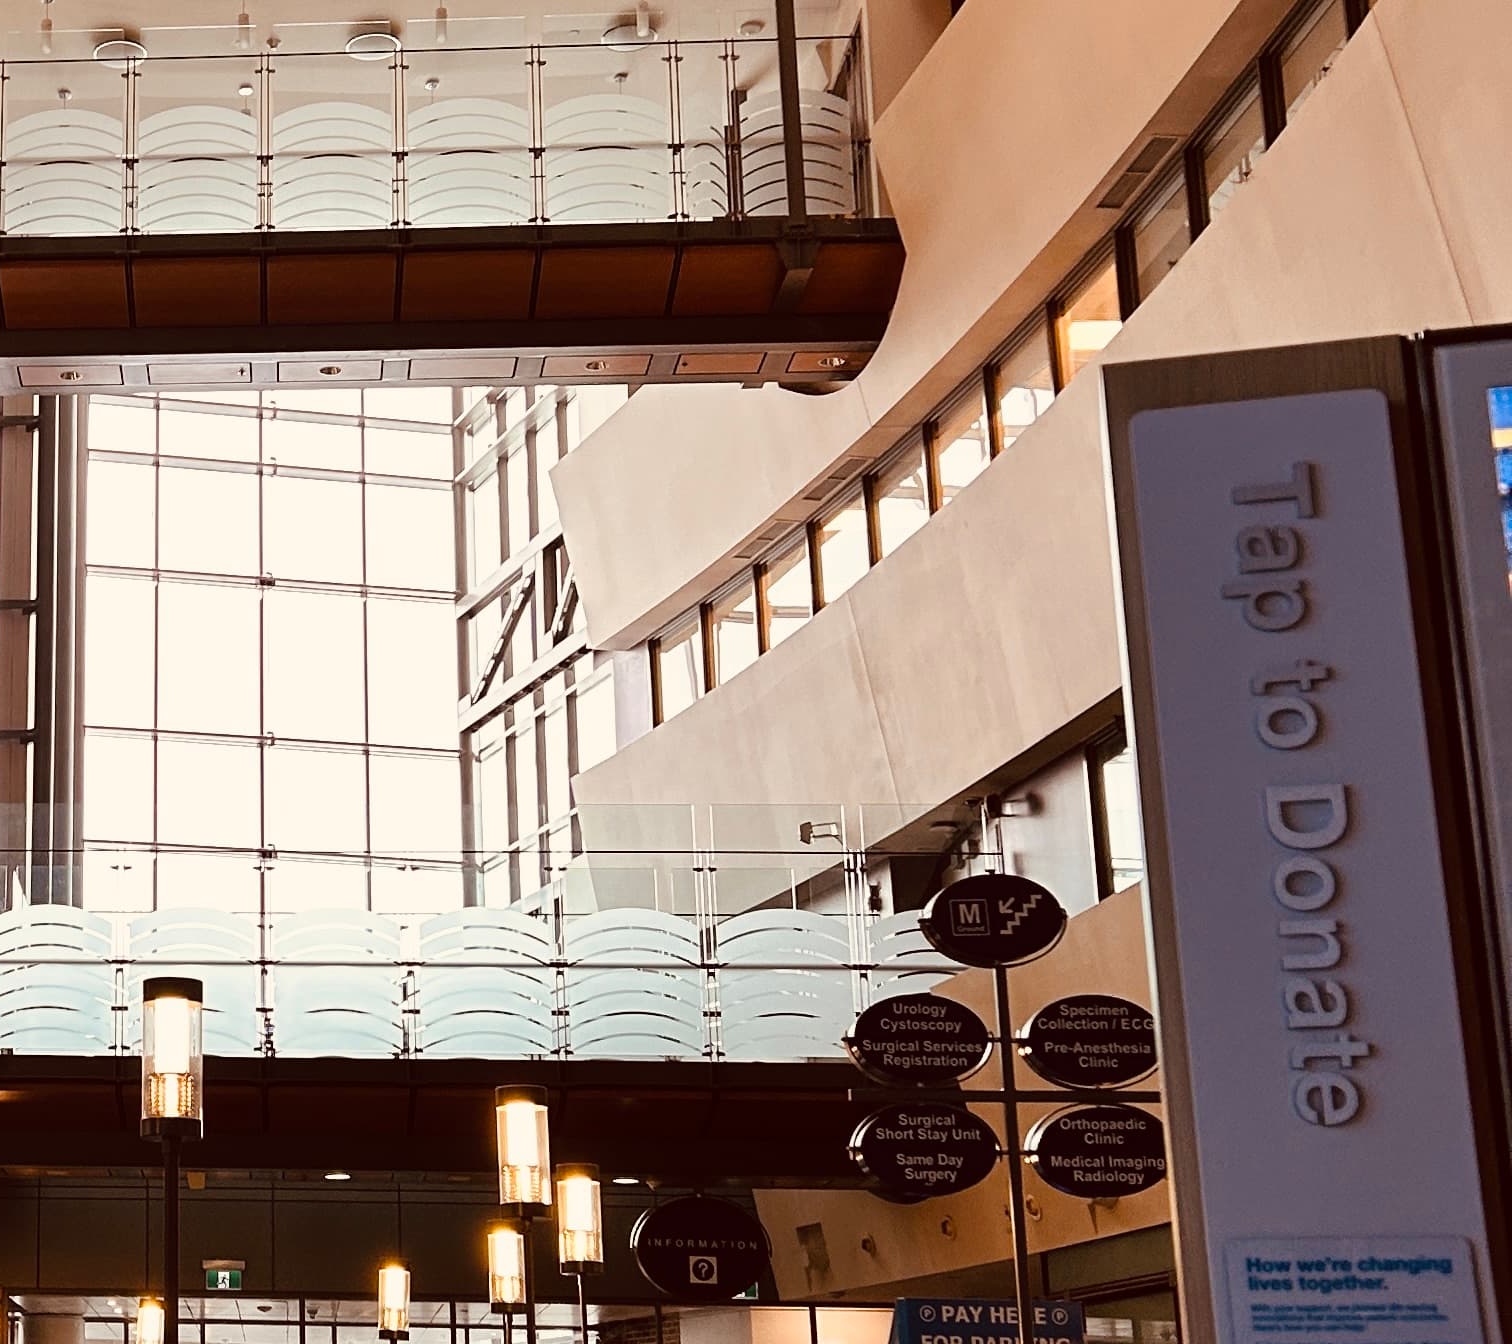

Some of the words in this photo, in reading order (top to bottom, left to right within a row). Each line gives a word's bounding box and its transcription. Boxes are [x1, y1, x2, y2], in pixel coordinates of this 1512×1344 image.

[1221, 460, 1318, 633] Tap
[1250, 659, 1334, 751] to
[958, 903, 981, 924] M
[1264, 783, 1374, 1128] Donate
[892, 1003, 947, 1018] Urology
[1059, 1004, 1128, 1019] Specimen
[880, 1019, 962, 1033] Cystoscopy
[1037, 1018, 1109, 1030] Collection
[1121, 1019, 1154, 1030] ECG
[862, 1040, 920, 1055] Surgical
[923, 1041, 982, 1054] Services
[1044, 1042, 1151, 1054] Pre-Anesthesia
[883, 1055, 968, 1069] Registration
[1078, 1056, 1119, 1068] Clinic
[898, 1114, 956, 1129] Surgical
[1059, 1118, 1147, 1133] Orthopaedic
[876, 1128, 914, 1141] Short
[917, 1129, 949, 1144] Stay
[952, 1129, 981, 1141] Unit
[1083, 1133, 1124, 1145] Clinic
[896, 1154, 935, 1167] Same
[937, 1154, 964, 1169] Day
[1050, 1155, 1106, 1168] Medical
[1109, 1156, 1166, 1171] Imaging
[904, 1168, 957, 1183] Surgery
[1073, 1169, 1145, 1184] Radiology
[647, 1238, 759, 1250] INFORMATION
[1245, 1257, 1291, 1273] How
[1297, 1257, 1352, 1273] we're
[1358, 1258, 1453, 1275] changing
[1248, 1276, 1293, 1291] lives
[1298, 1276, 1389, 1293] together.
[941, 1305, 984, 1324] PAY
[990, 1306, 1047, 1325] HEE
